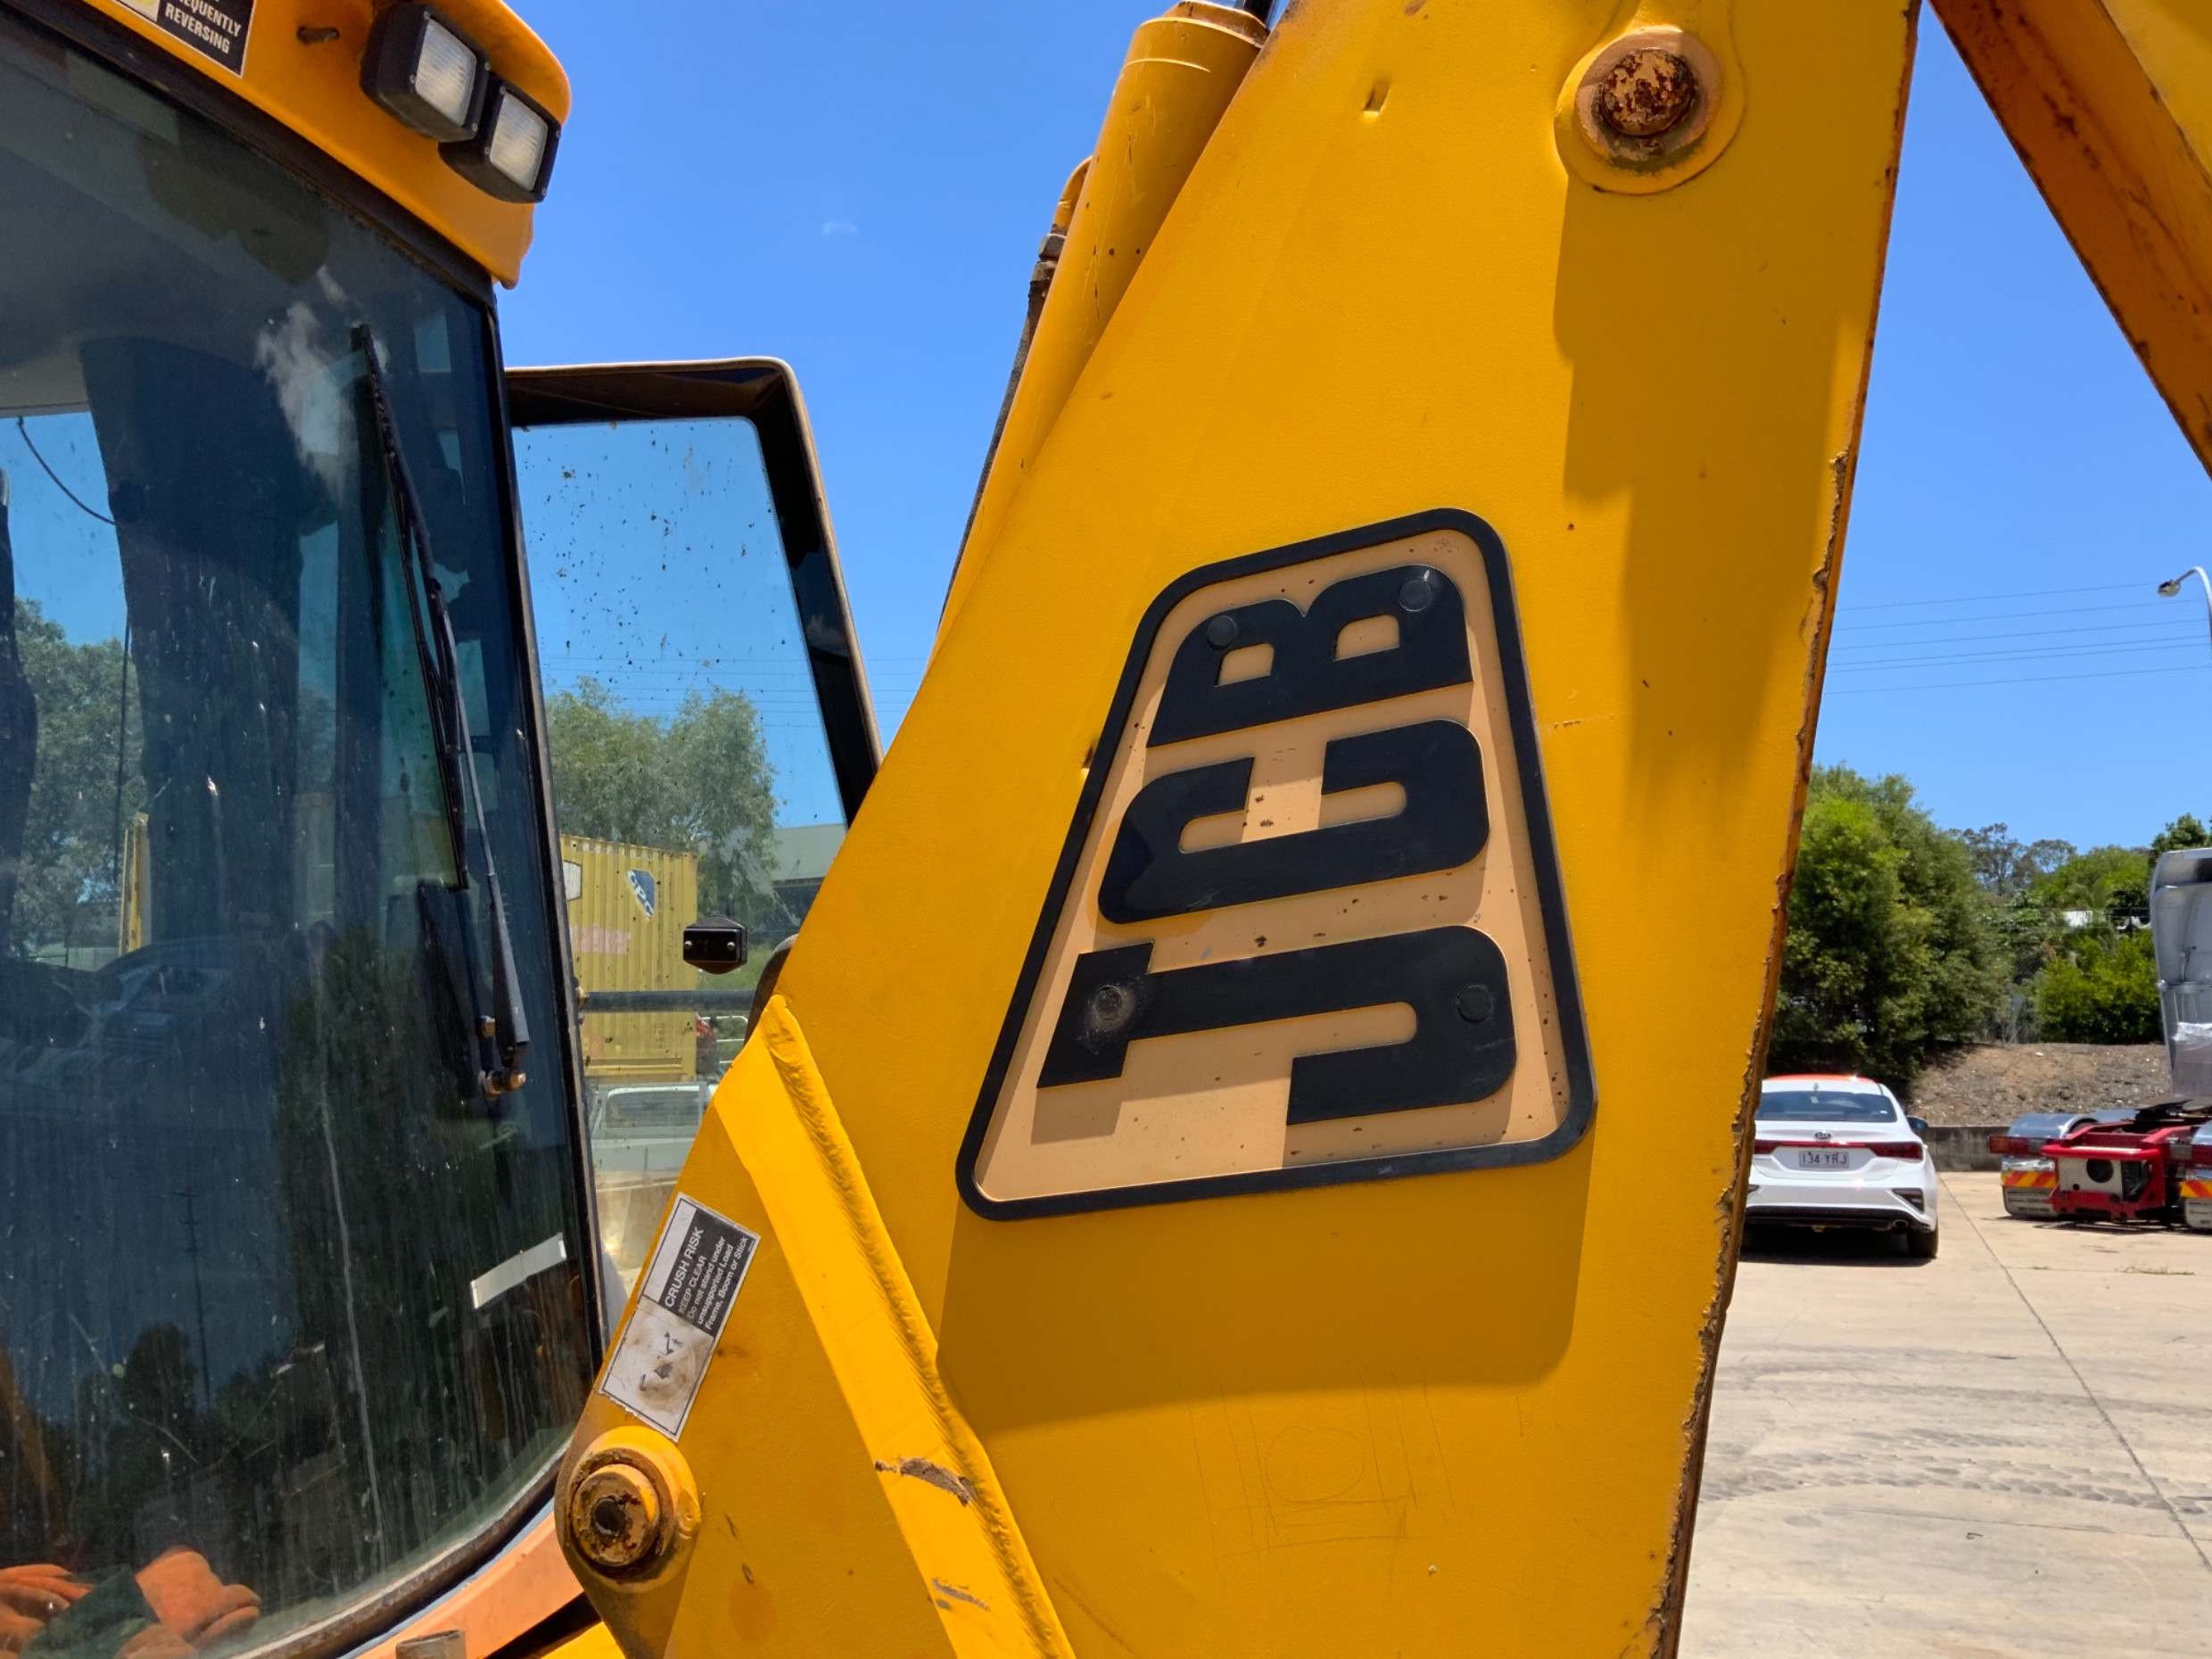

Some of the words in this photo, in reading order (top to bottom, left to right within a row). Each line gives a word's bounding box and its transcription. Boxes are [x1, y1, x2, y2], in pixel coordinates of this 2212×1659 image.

[165, 3, 230, 54] REVERSING
[1036, 564, 1517, 1127] JCB
[1802, 1153, 1820, 1164] 134
[1824, 1153, 1846, 1165] YRJ
[664, 1259, 690, 1308] CRUSH
[684, 1226, 704, 1259] RISK
[730, 1259, 739, 1270] or
[733, 1235, 748, 1259] Stick
[677, 1287, 692, 1315] KEEP
[689, 1255, 707, 1287] CLEAR
[687, 1306, 697, 1320] Do
[694, 1289, 705, 1307] not
[700, 1262, 715, 1289] stand
[711, 1235, 726, 1263] under
[697, 1268, 724, 1325] unsupported
[719, 1243, 734, 1268] Load
[717, 1270, 734, 1299] Boom
[705, 1300, 723, 1330] Frame,
